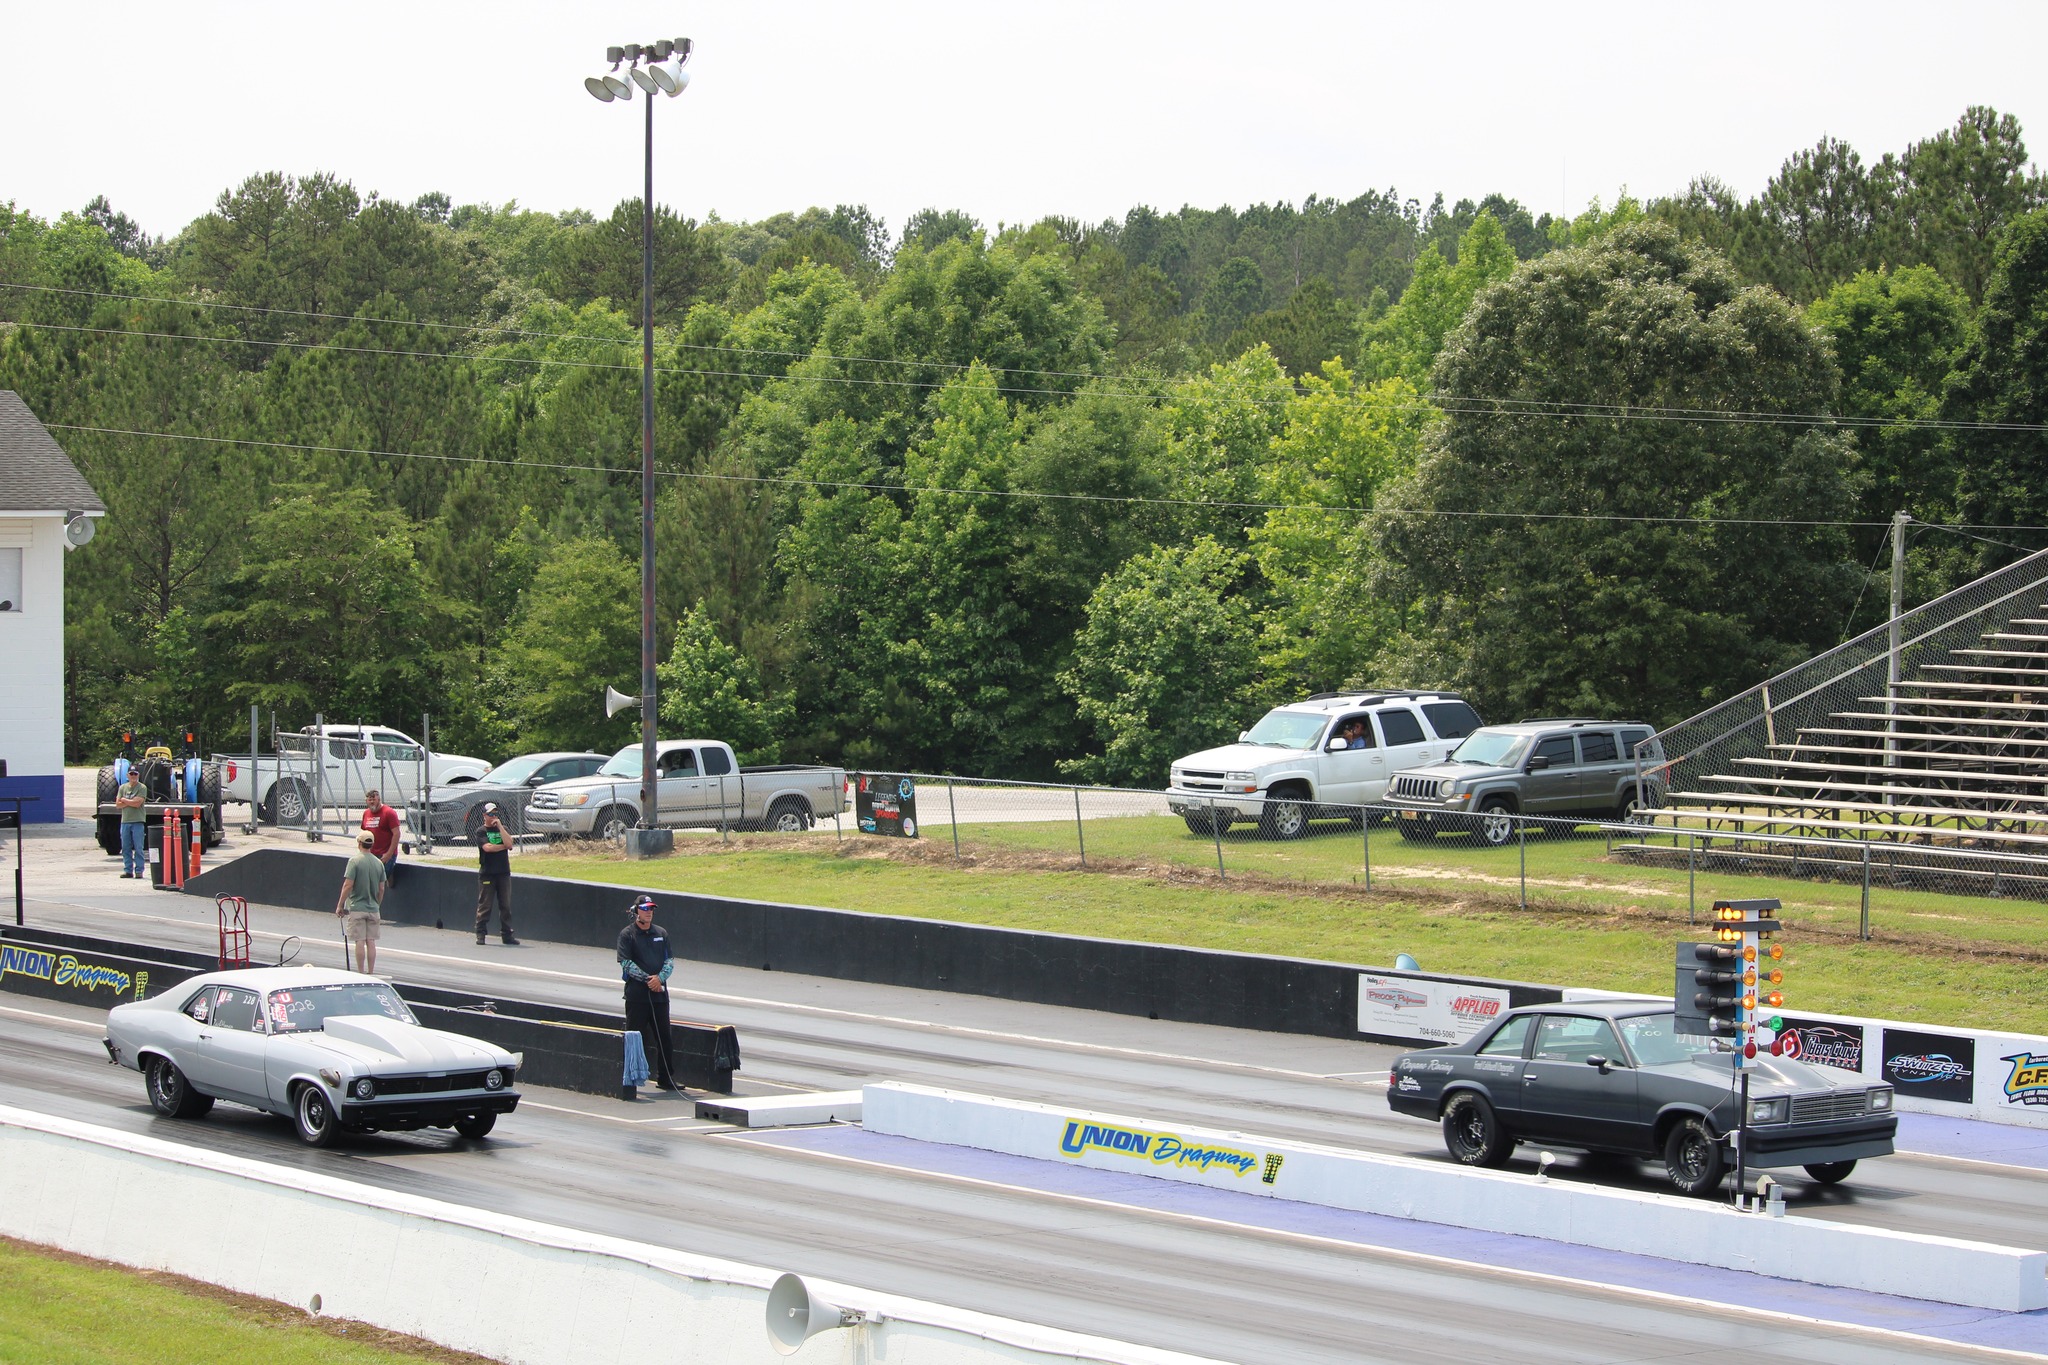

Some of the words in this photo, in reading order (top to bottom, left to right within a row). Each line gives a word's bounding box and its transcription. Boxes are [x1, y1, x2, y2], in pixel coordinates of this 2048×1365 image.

[0, 944, 56, 981] NION
[54, 955, 131, 995] Dragway
[243, 995, 256, 1005] 228
[286, 999, 316, 1014] 228
[1454, 996, 1501, 1017] APPLIED
[1419, 1027, 1456, 1039] 704-660-5060
[1886, 1056, 1972, 1076] SWITZER
[1891, 1068, 1962, 1081] DYNAMICS
[1061, 1121, 1153, 1154] UNION
[1152, 1136, 1256, 1174] Dragway
